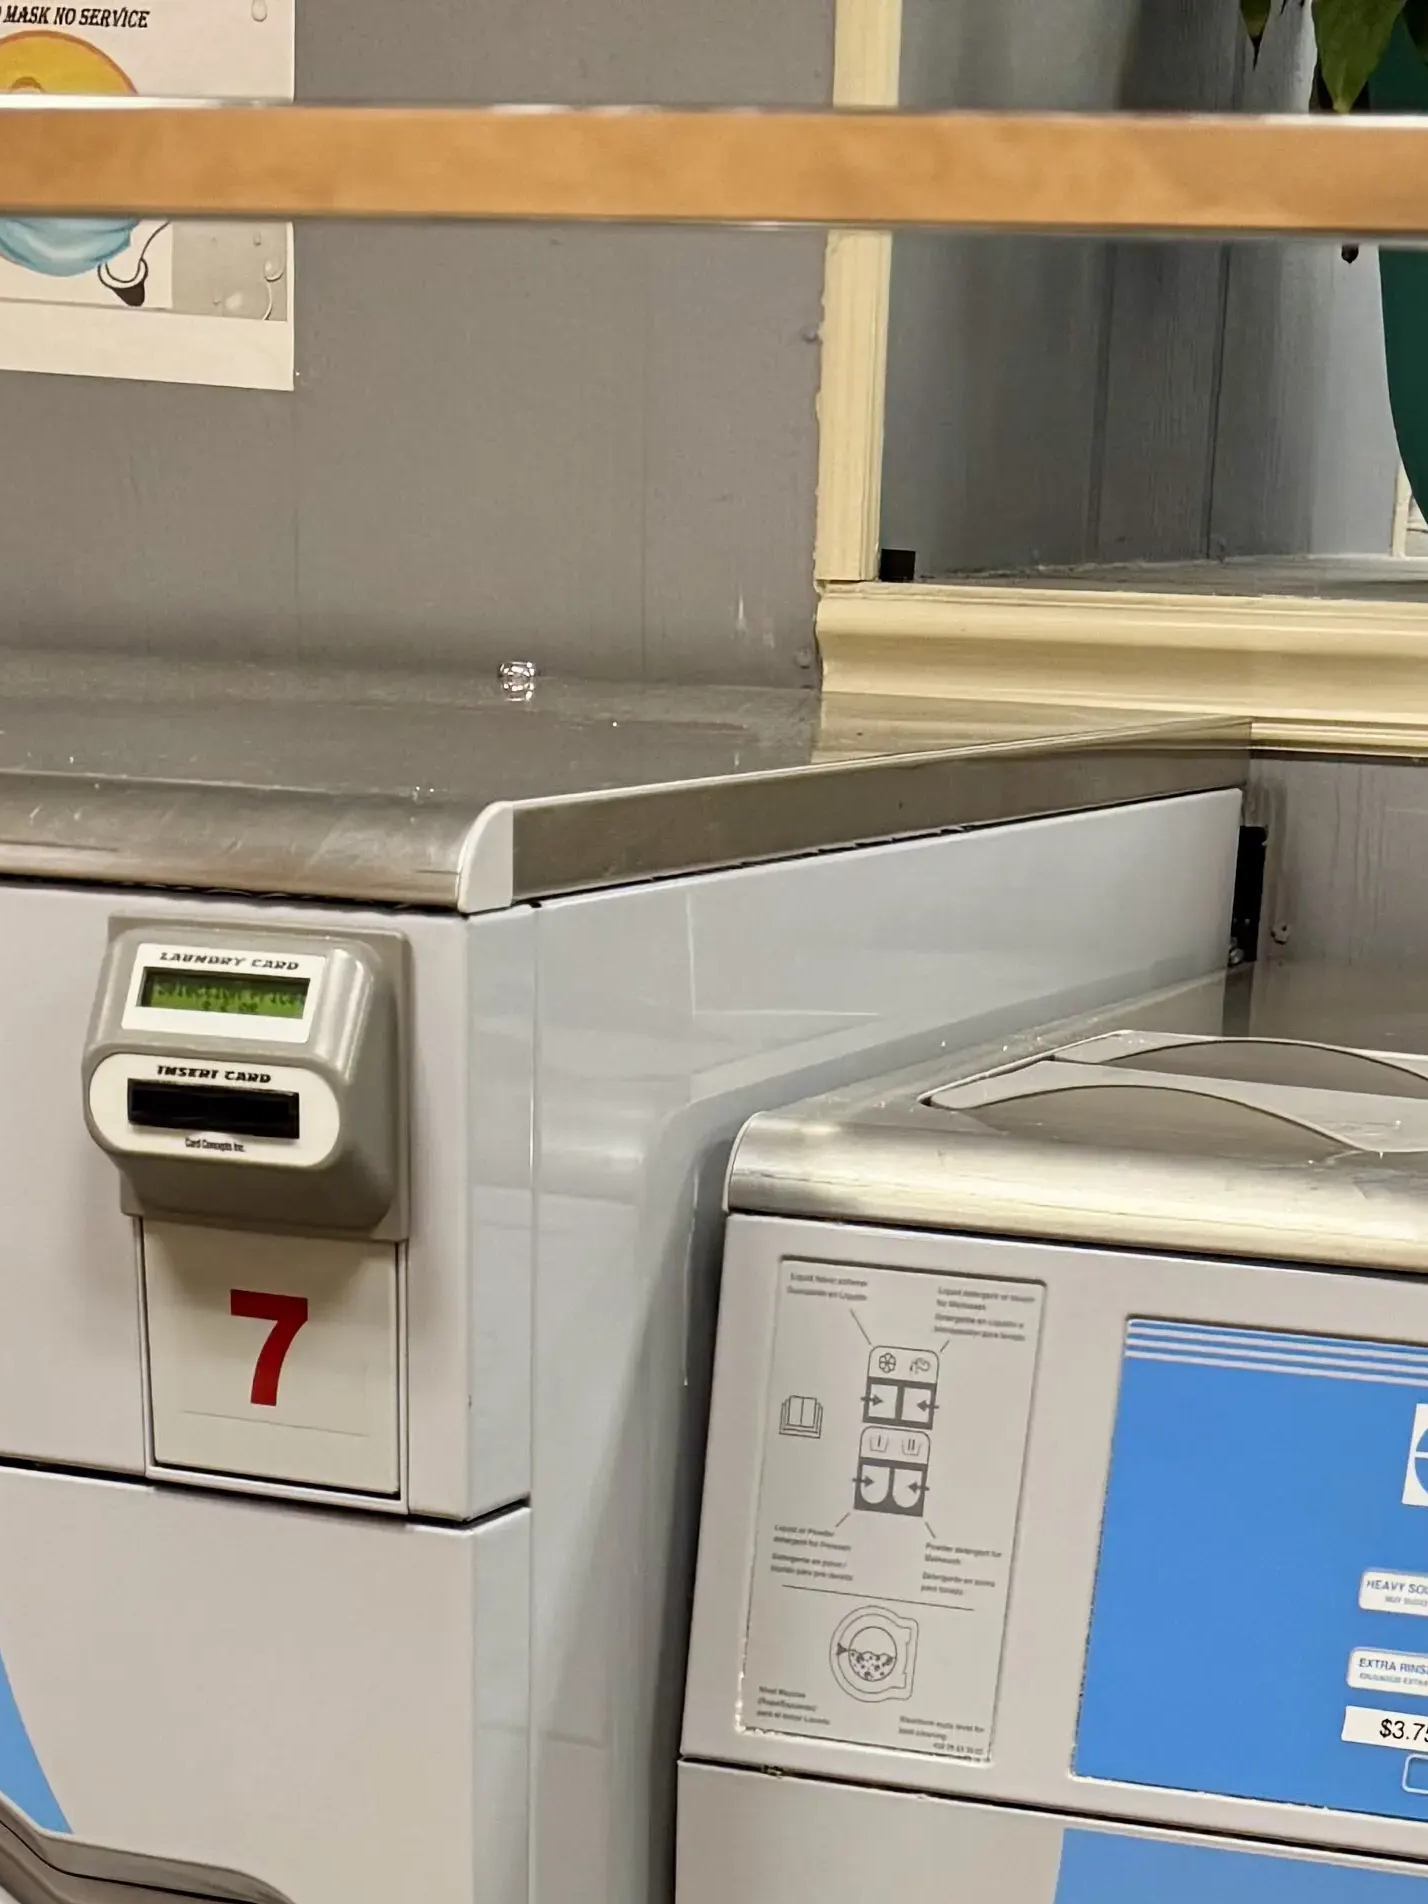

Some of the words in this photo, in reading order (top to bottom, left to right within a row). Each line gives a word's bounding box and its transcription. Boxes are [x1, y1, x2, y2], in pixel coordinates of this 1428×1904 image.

[3, 5, 51, 24] MASK
[53, 7, 76, 25] NO
[79, 8, 150, 28] SERVICE
[160, 952, 246, 967] LAUNDRY
[251, 959, 299, 971] CARD
[157, 1065, 219, 1079] INSERT
[224, 1071, 271, 1084] CARD
[230, 1288, 308, 1406] 7
[1366, 1580, 1406, 1592] HEAVY
[1359, 1658, 1396, 1671] EXTRA
